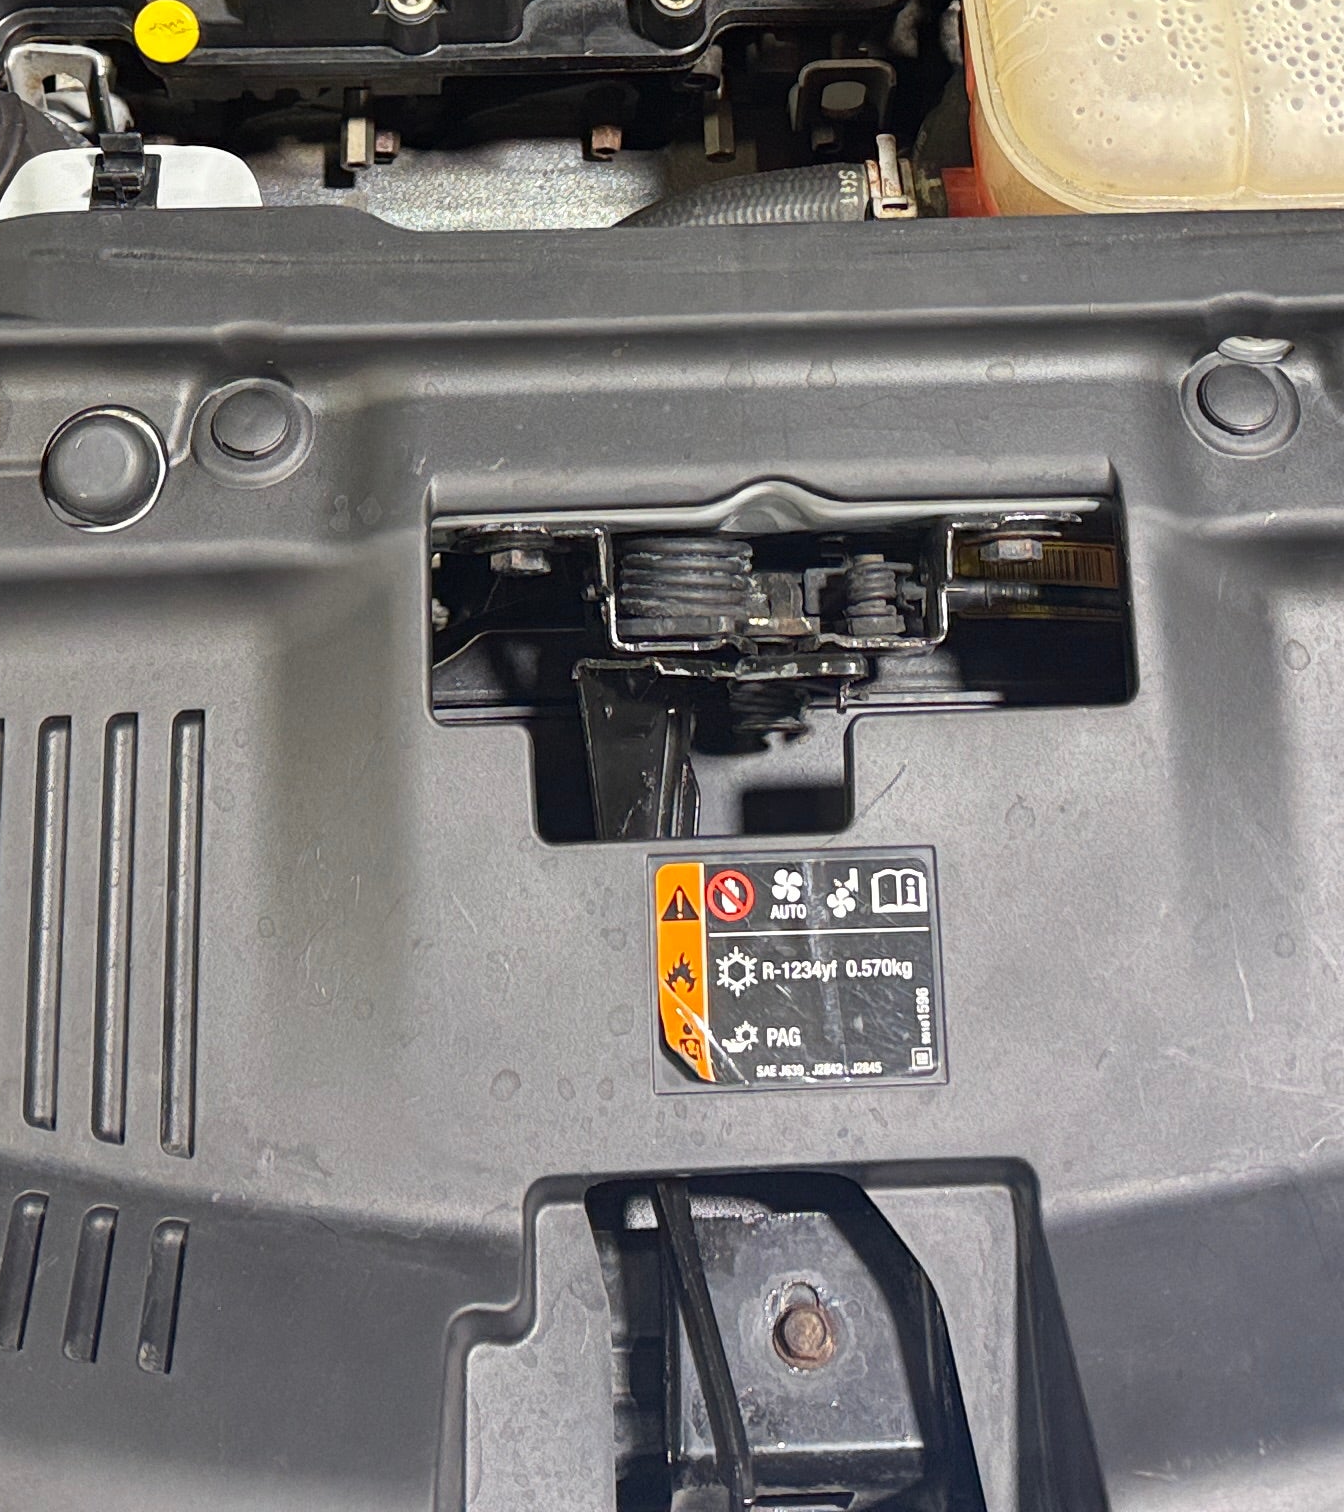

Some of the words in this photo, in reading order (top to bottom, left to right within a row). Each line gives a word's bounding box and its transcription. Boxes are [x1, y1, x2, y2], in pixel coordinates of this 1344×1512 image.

[770, 904, 806, 919] AUTO
[762, 960, 838, 982] R-1234yf
[846, 959, 913, 979] 0.570kg
[766, 1027, 802, 1046] PAG
[756, 1065, 777, 1078] SAE
